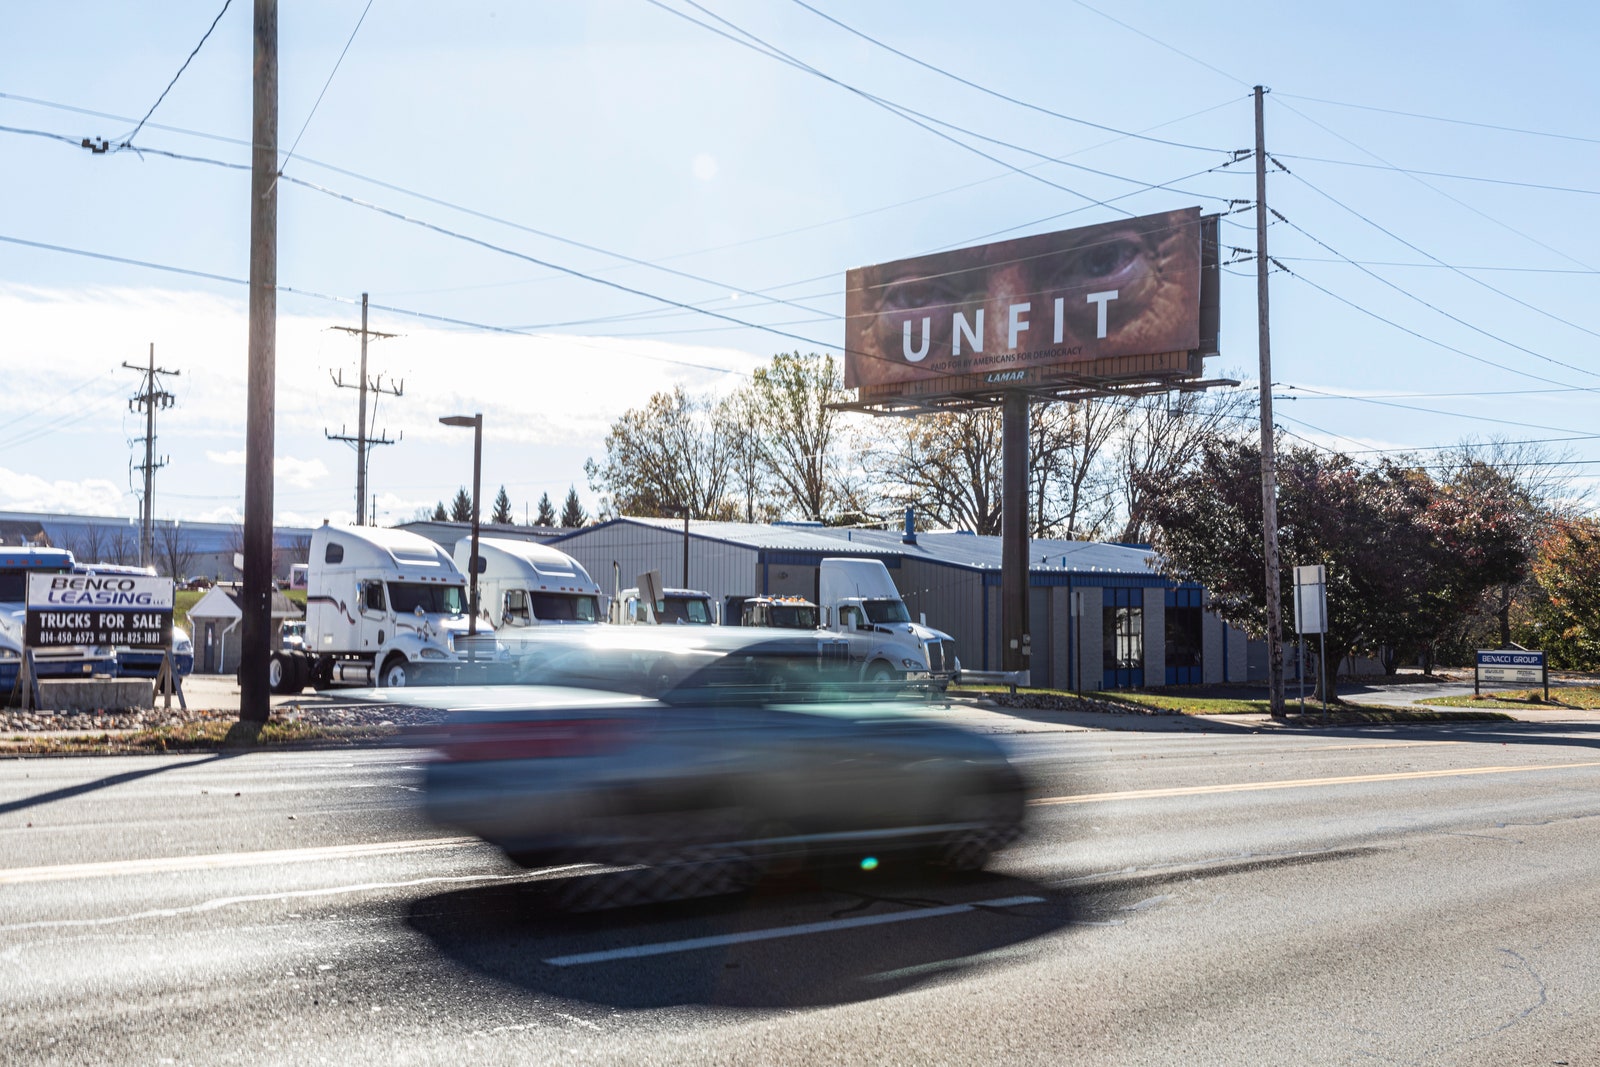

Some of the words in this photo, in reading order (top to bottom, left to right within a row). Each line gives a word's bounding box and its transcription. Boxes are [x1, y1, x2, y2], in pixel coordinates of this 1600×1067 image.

[902, 289, 1119, 363] UNFIT
[930, 361, 947, 371] PAID
[948, 360, 961, 369] FOR
[963, 359, 973, 368] BY
[973, 353, 1016, 366] AMERICANS
[1016, 351, 1032, 361] FOR
[1033, 346, 1083, 360] DEMOCRACY
[987, 370, 1025, 383] LAMAR
[50, 576, 136, 592] BENCO
[48, 591, 153, 605] LEASING
[39, 612, 91, 629] TRUCKS
[98, 613, 125, 629] FOR
[132, 613, 162, 629] SALE
[40, 631, 95, 644] 814-450-6573
[110, 631, 160, 644] 814-825-1881
[1482, 655, 1511, 663] BENACCI
[1512, 655, 1538, 664] GROUP
